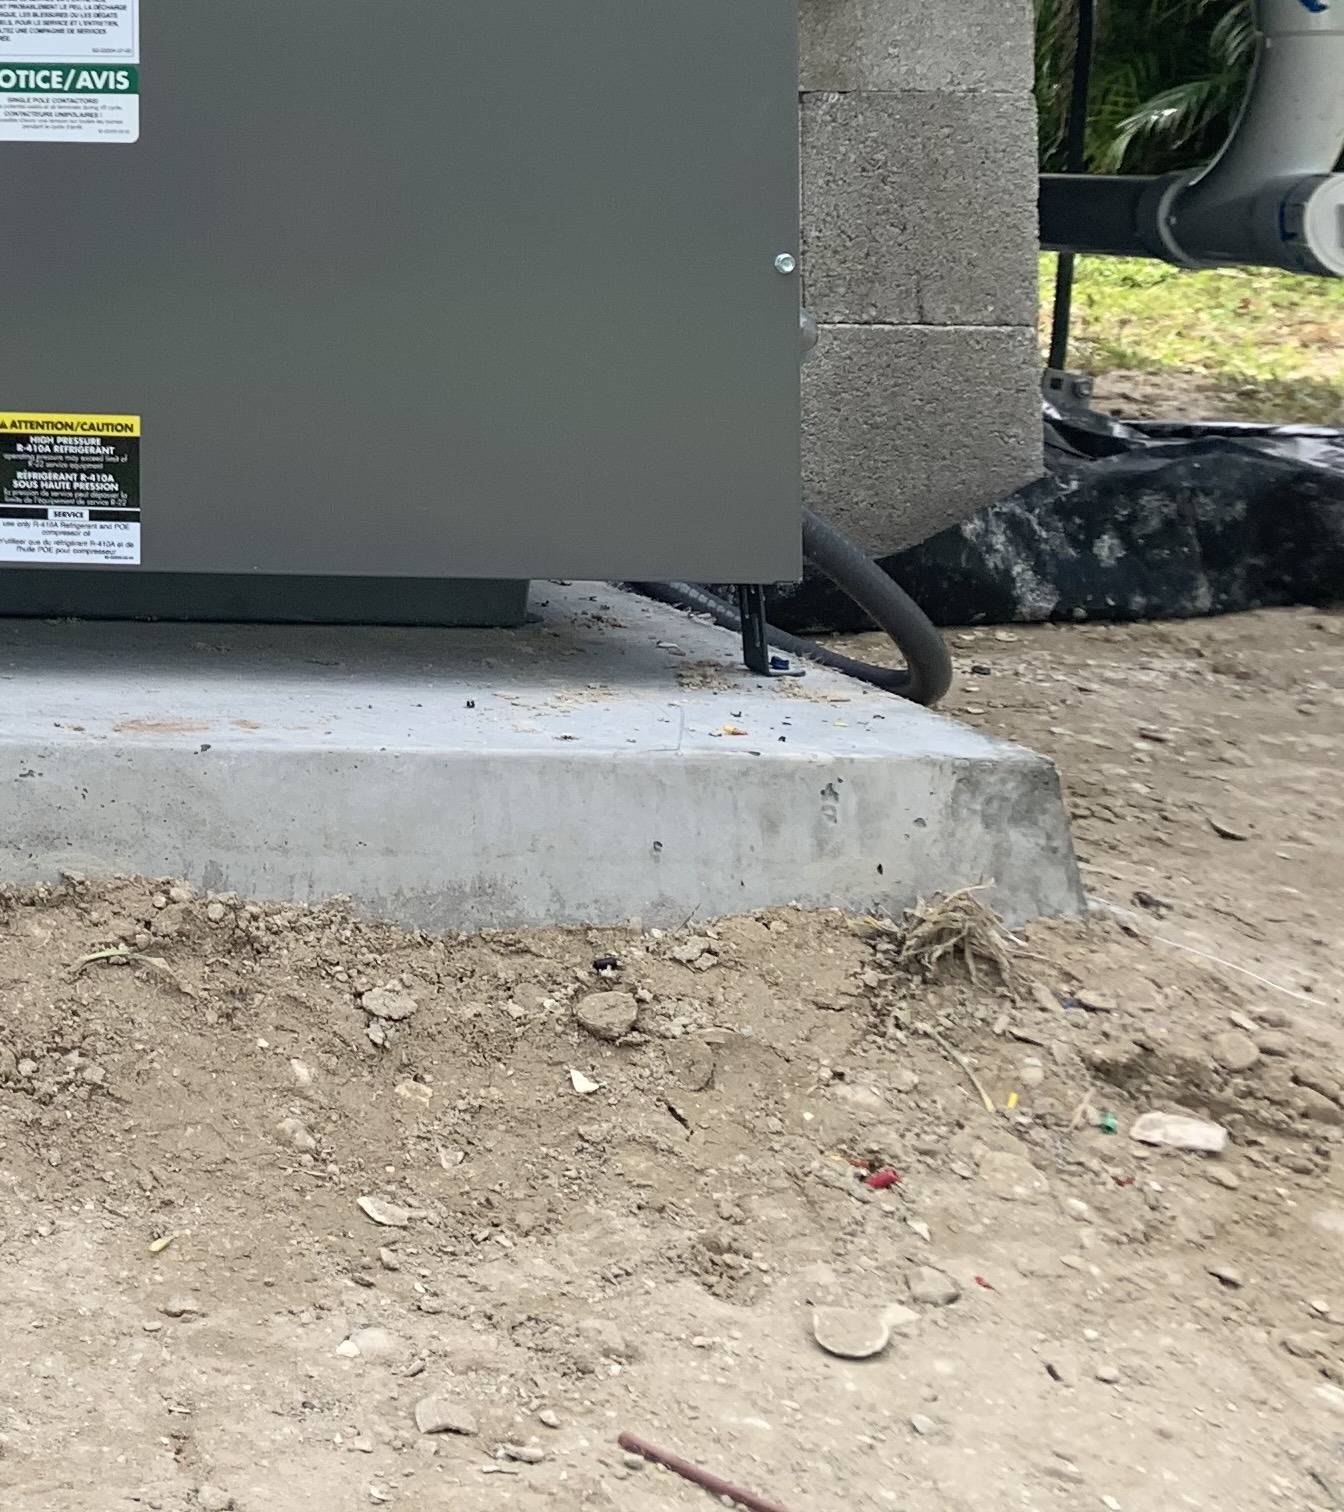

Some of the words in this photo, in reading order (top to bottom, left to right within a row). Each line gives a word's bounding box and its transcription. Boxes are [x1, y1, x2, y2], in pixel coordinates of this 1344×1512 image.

[10, 420, 134, 433] ATTENTION/CAUTION
[56, 437, 101, 445] PRESSURE
[16, 445, 50, 453] R-410A
[52, 445, 115, 454] REFRIGERANT
[79, 473, 114, 482] R-410A
[13, 480, 38, 490] SOUS
[40, 481, 70, 490] HAUTE
[72, 482, 118, 491] PRESSION
